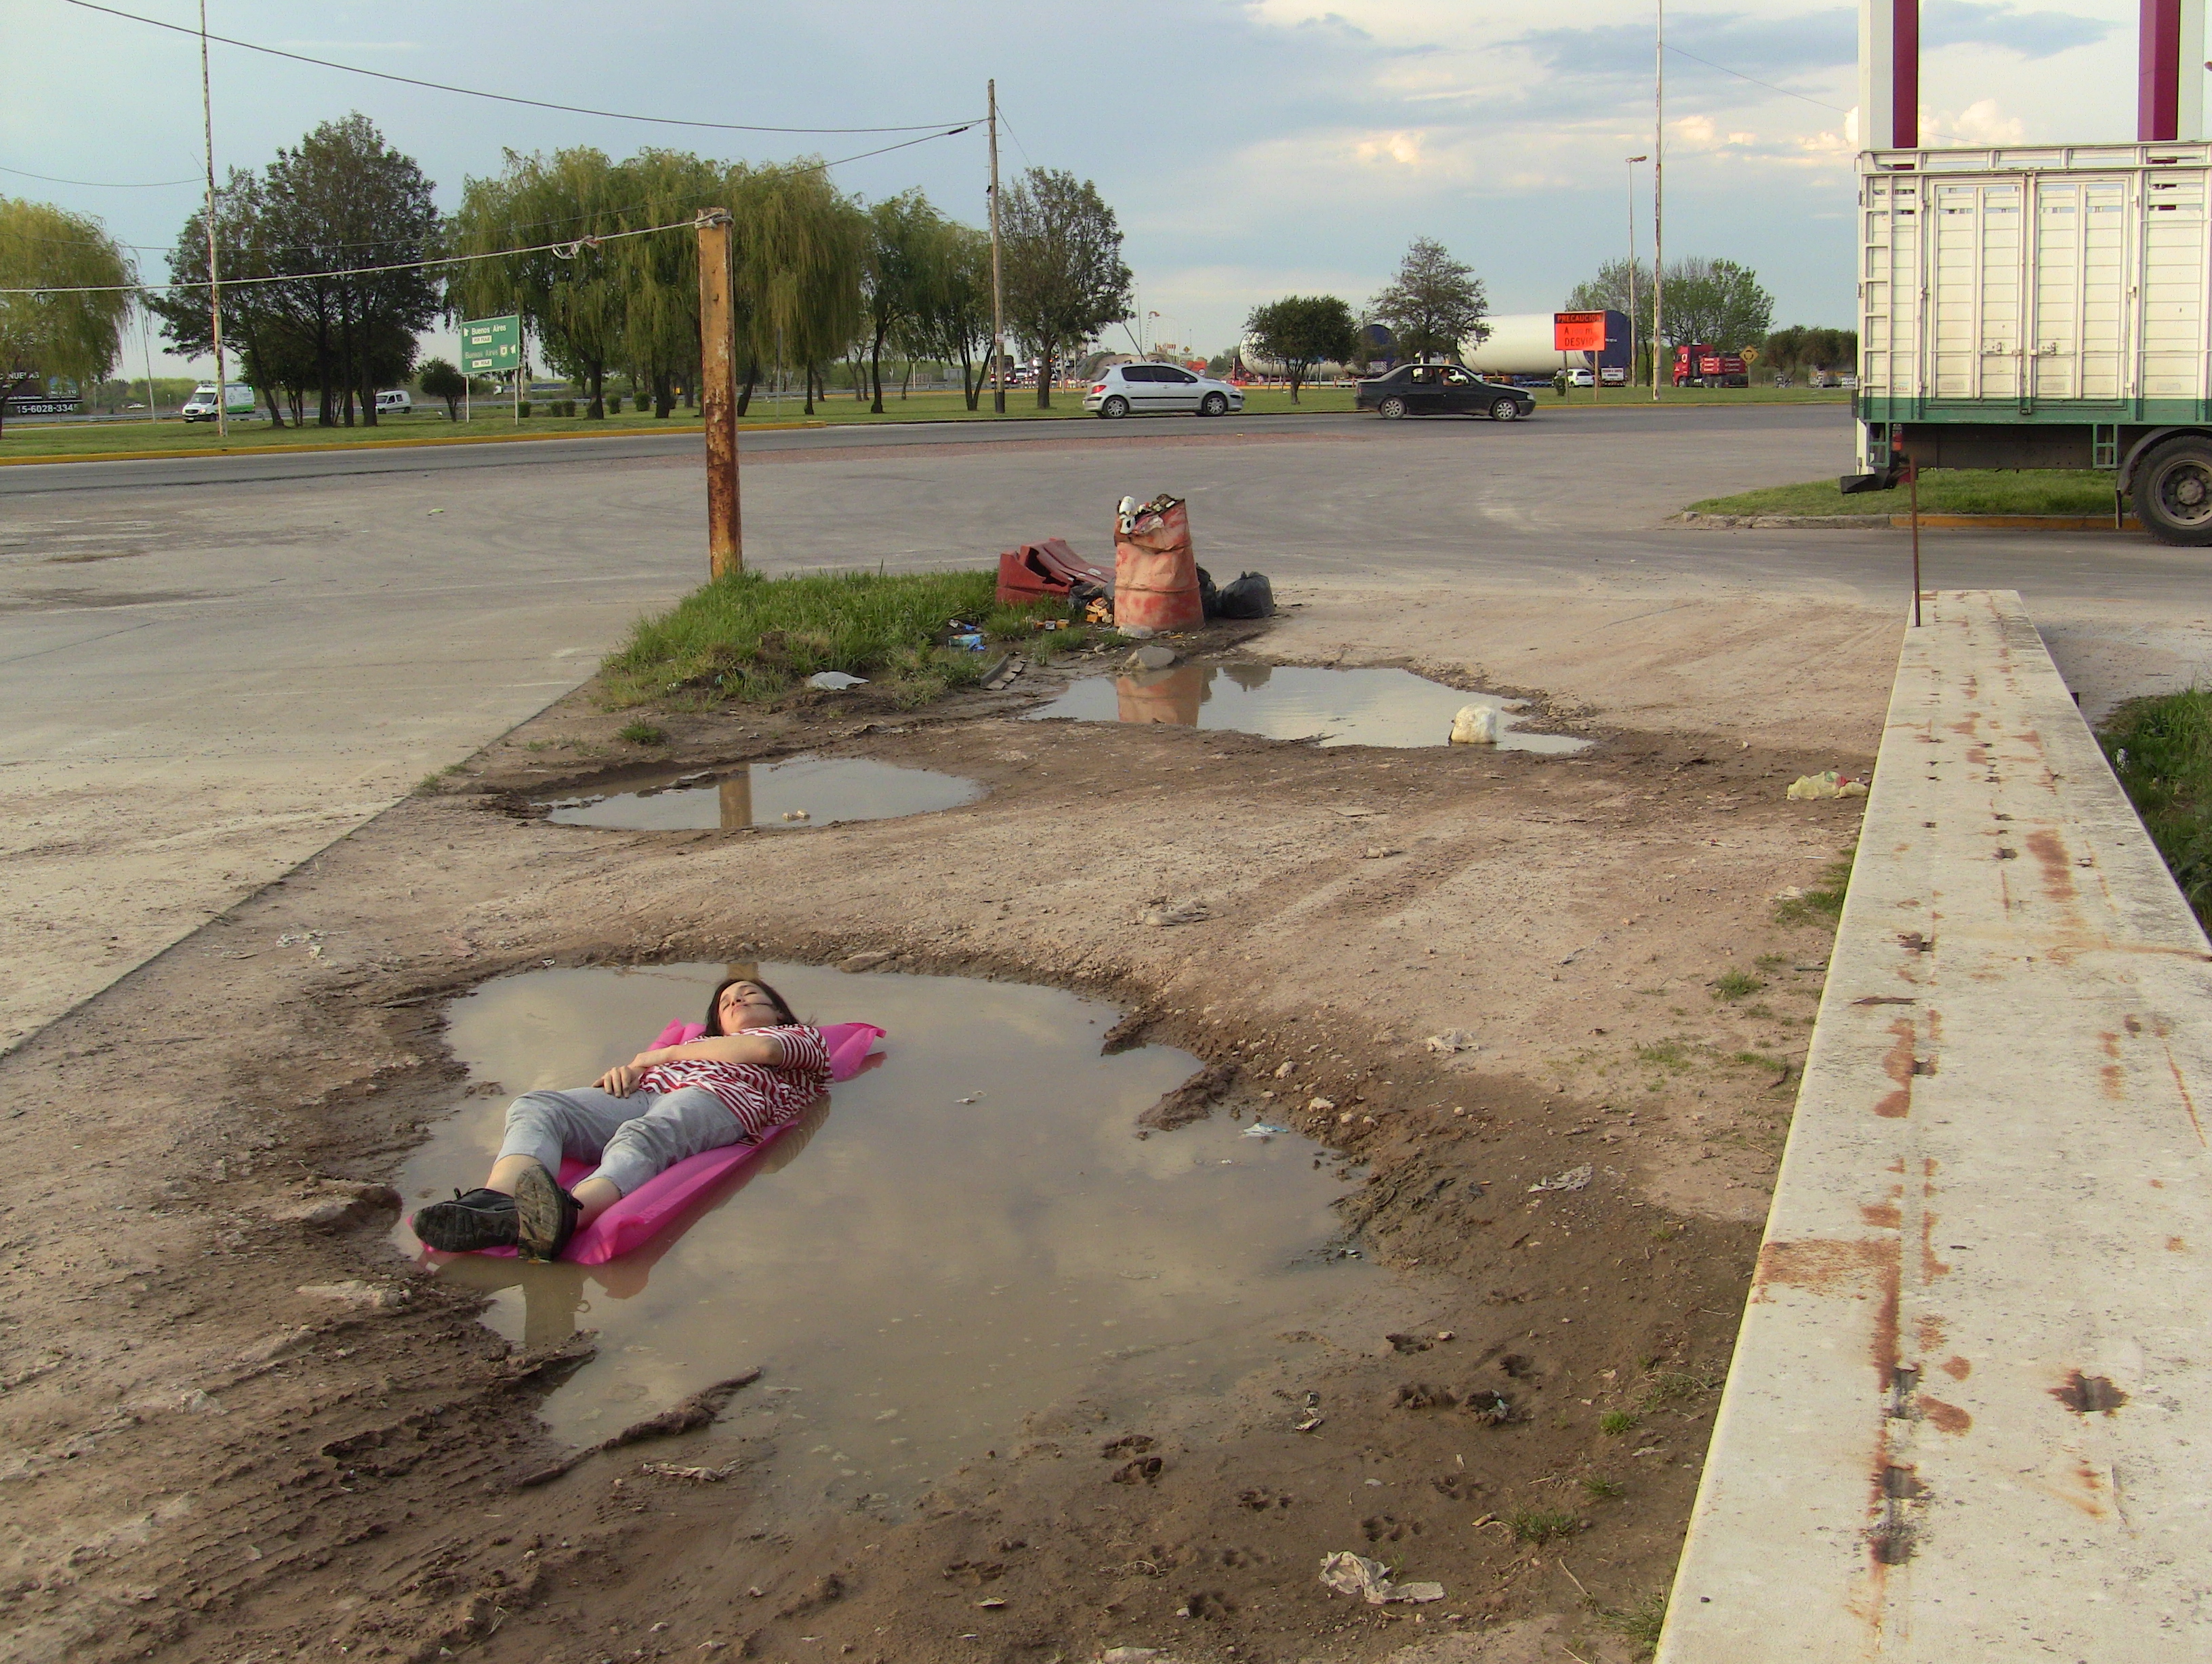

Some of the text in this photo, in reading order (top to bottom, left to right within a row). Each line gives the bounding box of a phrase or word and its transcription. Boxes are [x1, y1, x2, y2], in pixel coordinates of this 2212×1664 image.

[472, 325, 506, 335] Buenos Aires
[1564, 327, 1569, 335] A
[1565, 337, 1594, 346] DESVIO
[466, 351, 483, 359] Buenos
